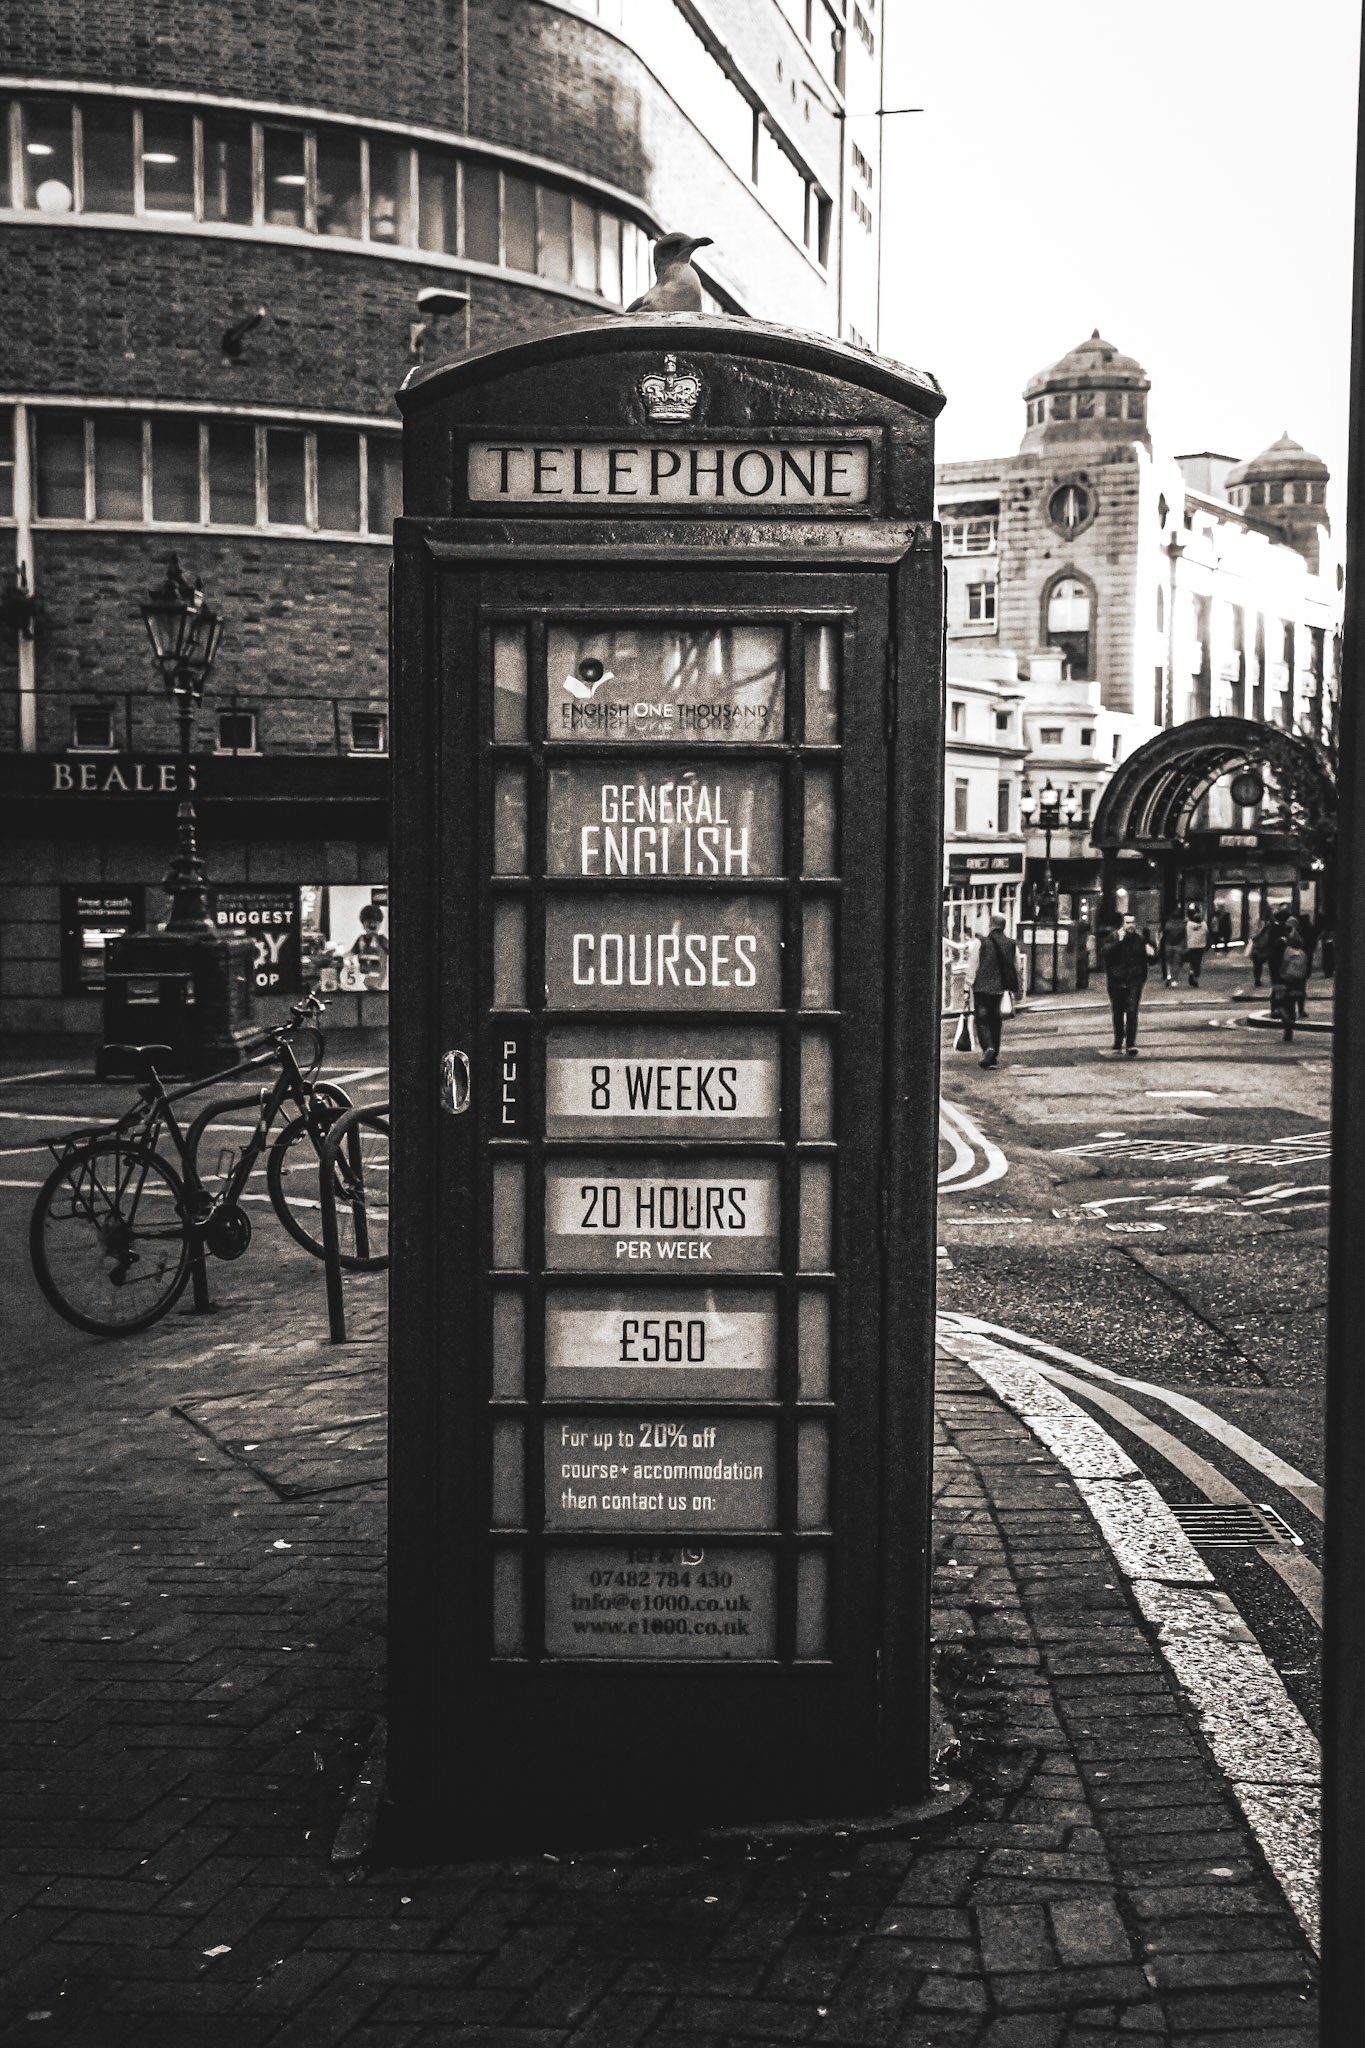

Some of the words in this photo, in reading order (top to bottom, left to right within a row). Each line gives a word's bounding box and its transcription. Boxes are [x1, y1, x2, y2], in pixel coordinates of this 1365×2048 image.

[486, 447, 853, 496] TELEPHONE
[562, 703, 629, 718] ENGLISH
[634, 703, 673, 718] ONE
[677, 704, 768, 718] THOUSAND
[602, 785, 729, 823] GENERAL
[217, 911, 293, 924] BIGGEST
[573, 934, 757, 986] COURSES
[502, 1041, 517, 1123] PULL
[591, 1066, 610, 1109] 8
[625, 1067, 737, 1110] WEEKS
[581, 1186, 620, 1228] 20
[636, 1187, 746, 1229] HOURS
[616, 1242, 651, 1258] PER
[657, 1242, 713, 1259] WEEK
[619, 1320, 705, 1361] £560
[561, 1426, 588, 1447] For
[594, 1433, 613, 1450] up
[618, 1431, 634, 1447] to
[639, 1423, 688, 1448] 20%
[692, 1427, 716, 1448] off
[633, 1459, 763, 1480] accommodation
[562, 1488, 597, 1509] then
[602, 1493, 664, 1510] contact
[668, 1496, 687, 1510] us
[692, 1496, 716, 1510] on:
[589, 1571, 650, 1587] 07482
[656, 1571, 691, 1588] 784
[696, 1572, 732, 1588] 430
[571, 1594, 752, 1612] info@e1000.co.uk
[572, 1618, 750, 1635] www.e1000.co.uk
